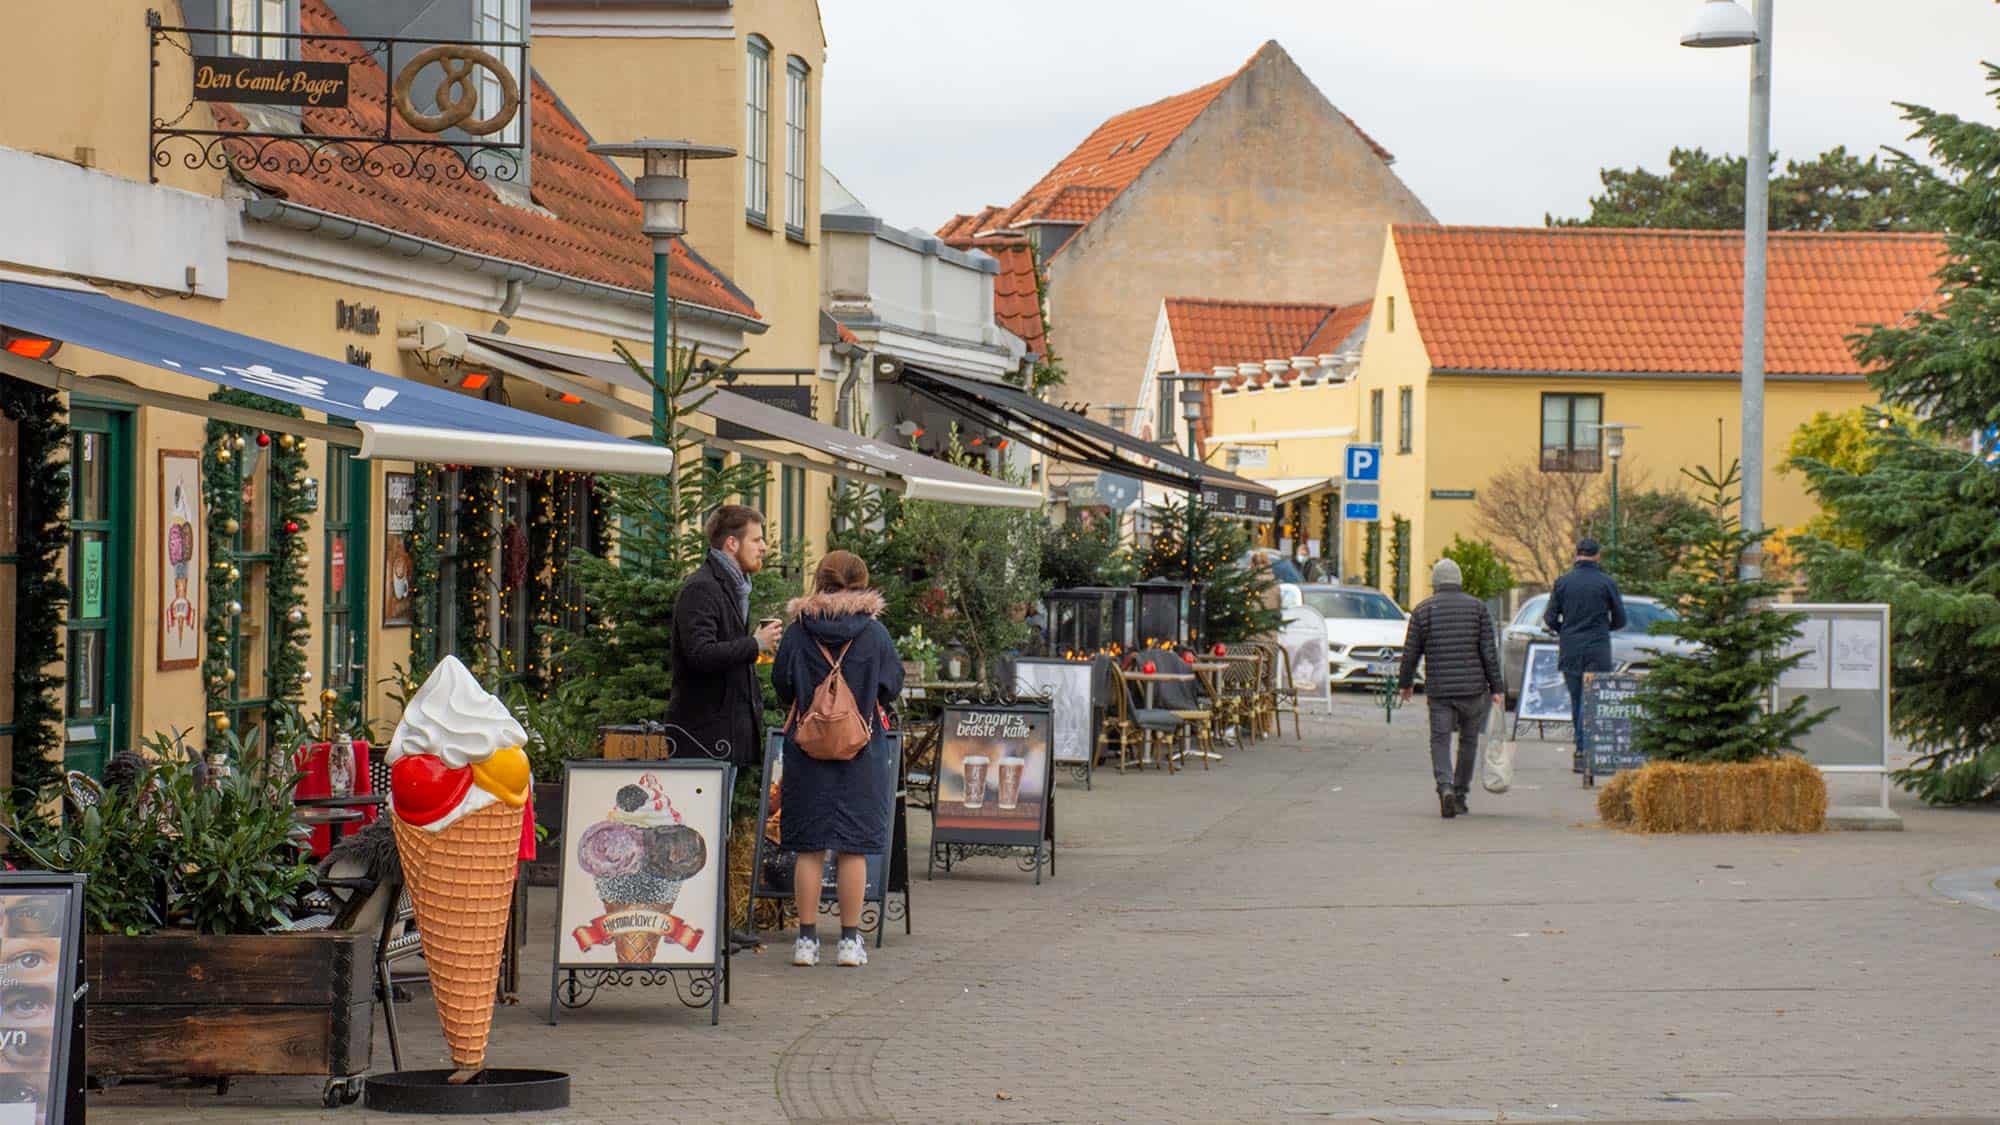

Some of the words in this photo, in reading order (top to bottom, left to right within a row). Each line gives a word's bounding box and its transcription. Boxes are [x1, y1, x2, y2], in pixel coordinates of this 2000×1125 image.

[196, 65, 231, 89] Den
[235, 68, 290, 92] Gamle
[291, 71, 344, 104] Bager
[1353, 450, 1373, 478] P
[957, 721, 996, 737] bedste
[1002, 723, 1030, 738] kaffe
